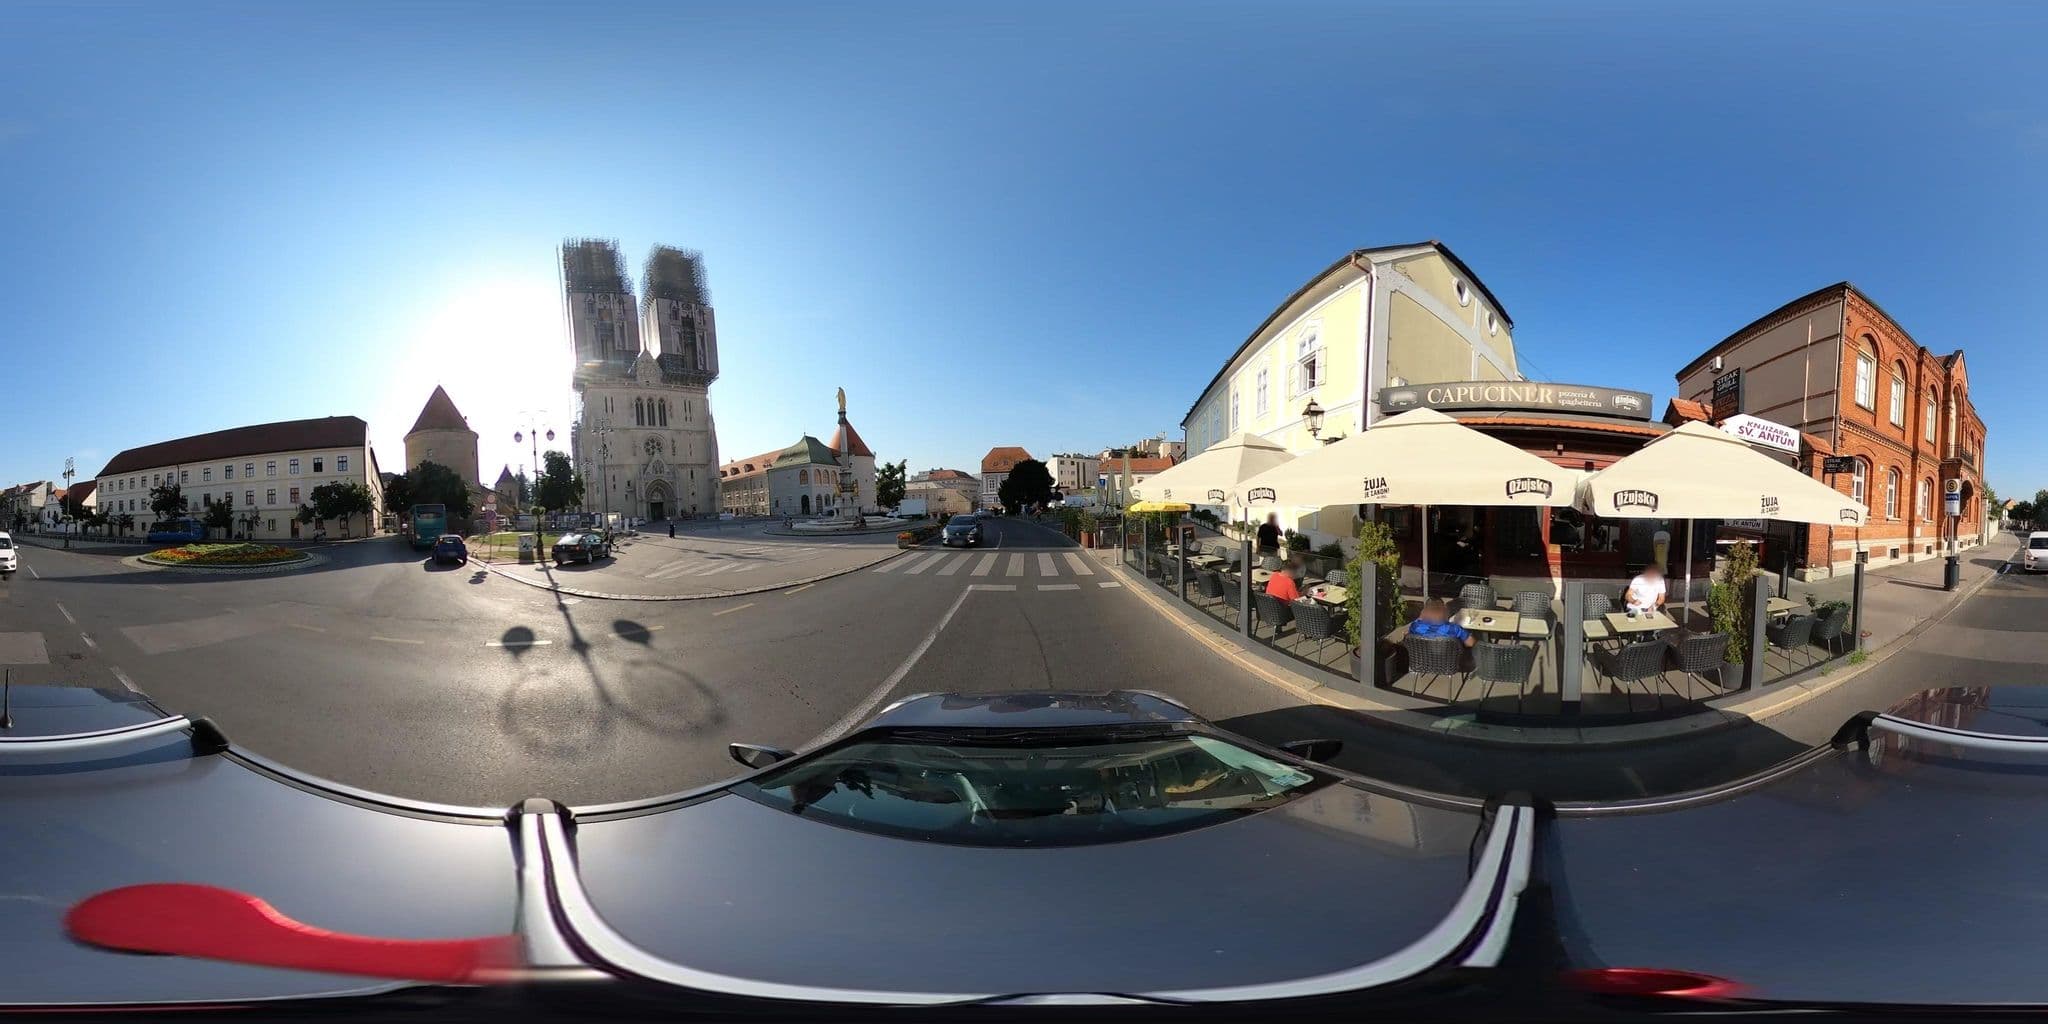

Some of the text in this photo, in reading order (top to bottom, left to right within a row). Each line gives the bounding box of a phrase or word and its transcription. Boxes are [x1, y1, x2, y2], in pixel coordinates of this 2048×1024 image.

[1427, 386, 1553, 404] CAPUCINER
[1589, 391, 1597, 399] &
[1738, 425, 1796, 448] SV. ANTUN
[1509, 478, 1550, 494] Ožujsko
[1616, 491, 1656, 506] Ožujsko
